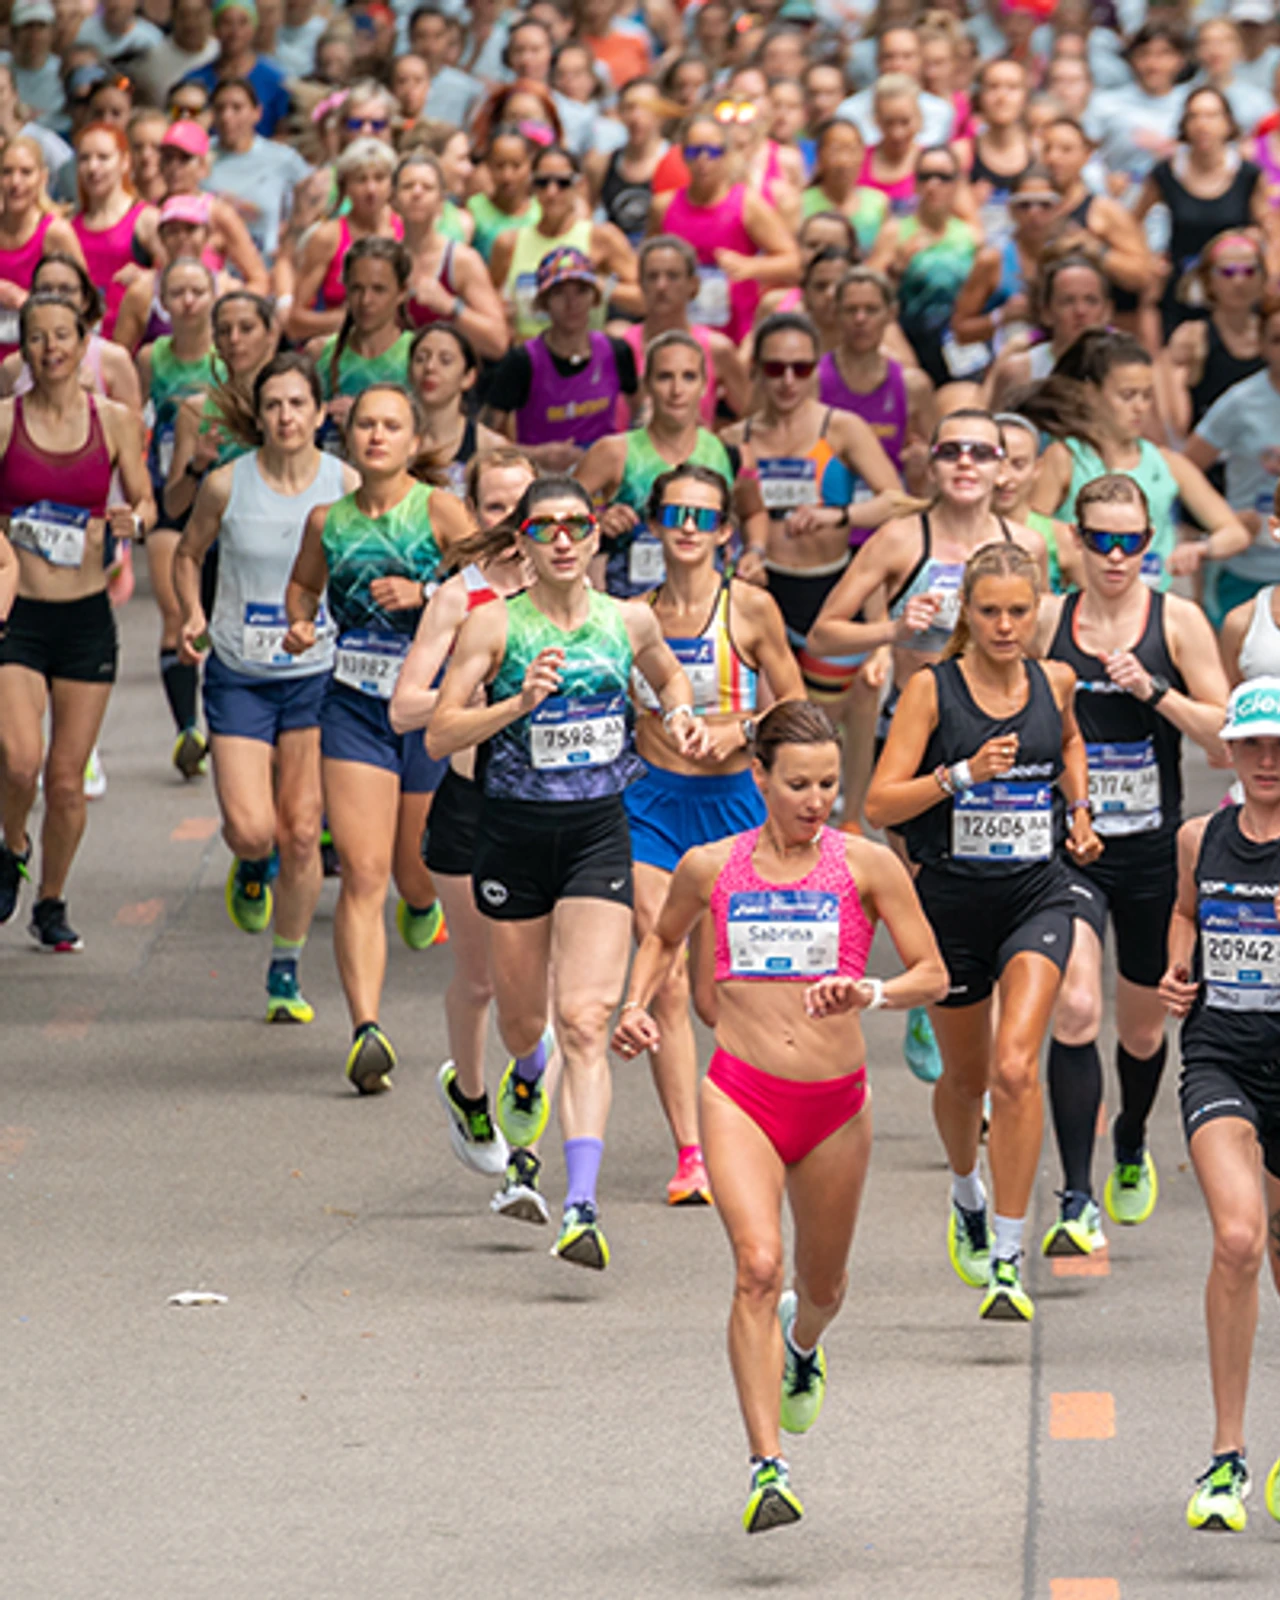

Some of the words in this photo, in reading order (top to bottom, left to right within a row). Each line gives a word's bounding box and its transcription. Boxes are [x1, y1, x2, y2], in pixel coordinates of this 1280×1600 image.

[962, 816, 1025, 839] 12606
[748, 924, 813, 942] Sabrina
[1207, 937, 1274, 961] 20942
